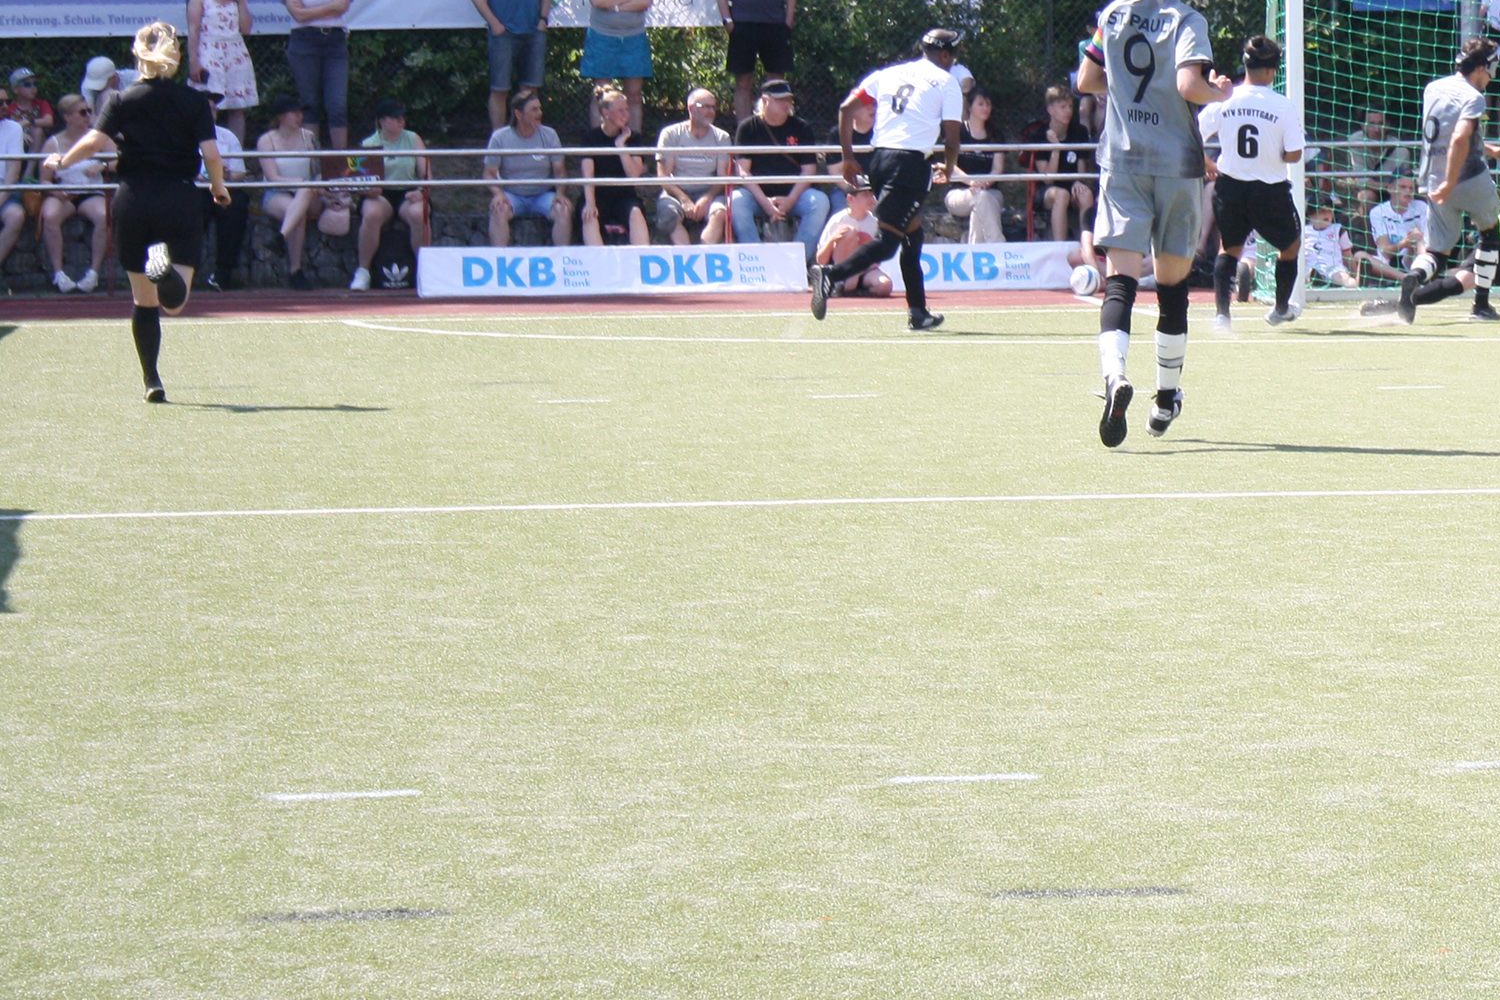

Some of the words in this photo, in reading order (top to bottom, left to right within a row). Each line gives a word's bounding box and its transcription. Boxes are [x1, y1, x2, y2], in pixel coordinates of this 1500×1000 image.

[64, 14, 105, 25] Schule.
[1123, 33, 1156, 104] 9
[891, 83, 916, 115] 8
[1127, 108, 1159, 126] HIPPO
[1238, 108, 1279, 124] STUTTGART
[1237, 123, 1260, 159] 6
[562, 256, 583, 266] Das
[738, 252, 759, 262] Das
[639, 253, 733, 285] DKB
[739, 264, 766, 273] kann
[1005, 262, 1031, 270] kann
[462, 256, 556, 288] DKB
[563, 268, 590, 278] kann
[1005, 272, 1031, 281] Bank
[563, 278, 591, 288] Bank
[740, 274, 767, 284] Bank
